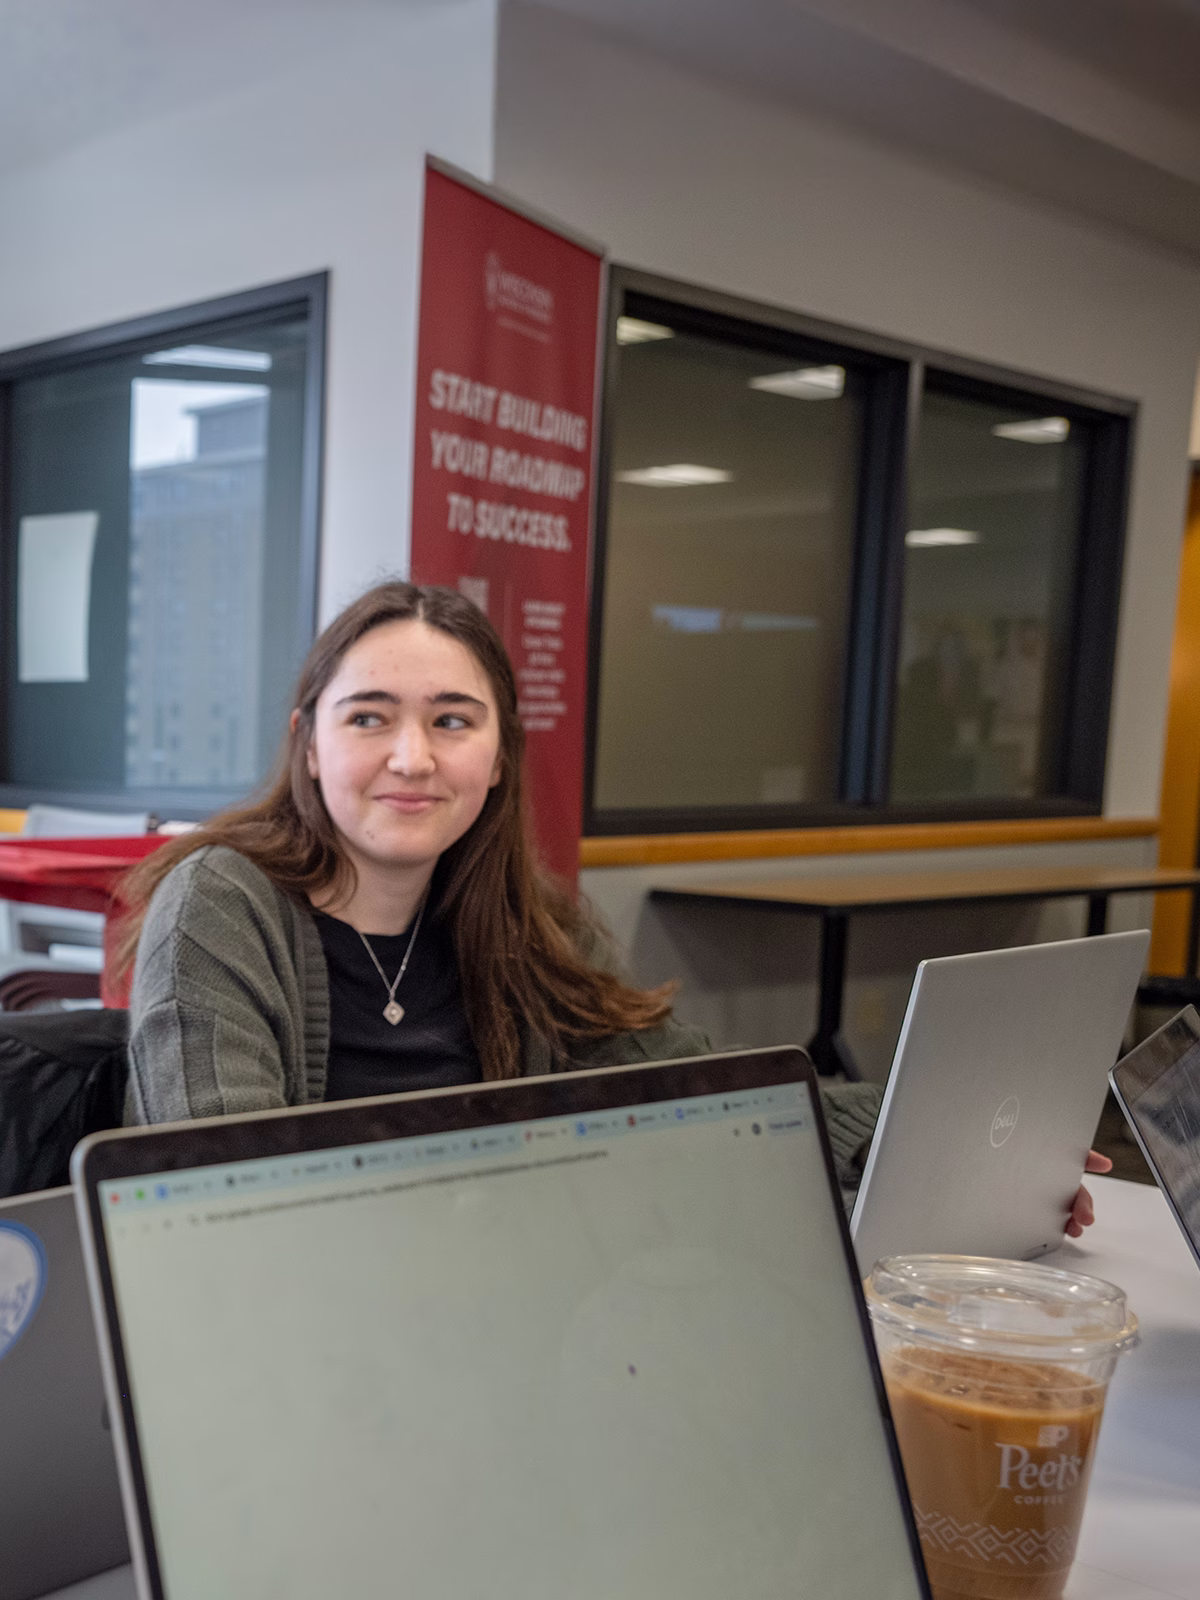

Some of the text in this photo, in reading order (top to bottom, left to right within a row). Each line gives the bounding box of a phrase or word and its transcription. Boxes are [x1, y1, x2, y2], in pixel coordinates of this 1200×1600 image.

[430, 371, 586, 450] START BUILDING
[431, 431, 584, 499] YOUR ROADMAP
[448, 493, 571, 551] TO SUCCESS.
[995, 1114, 1015, 1129] DELL
[1013, 1494, 1064, 1506] COFFEE
